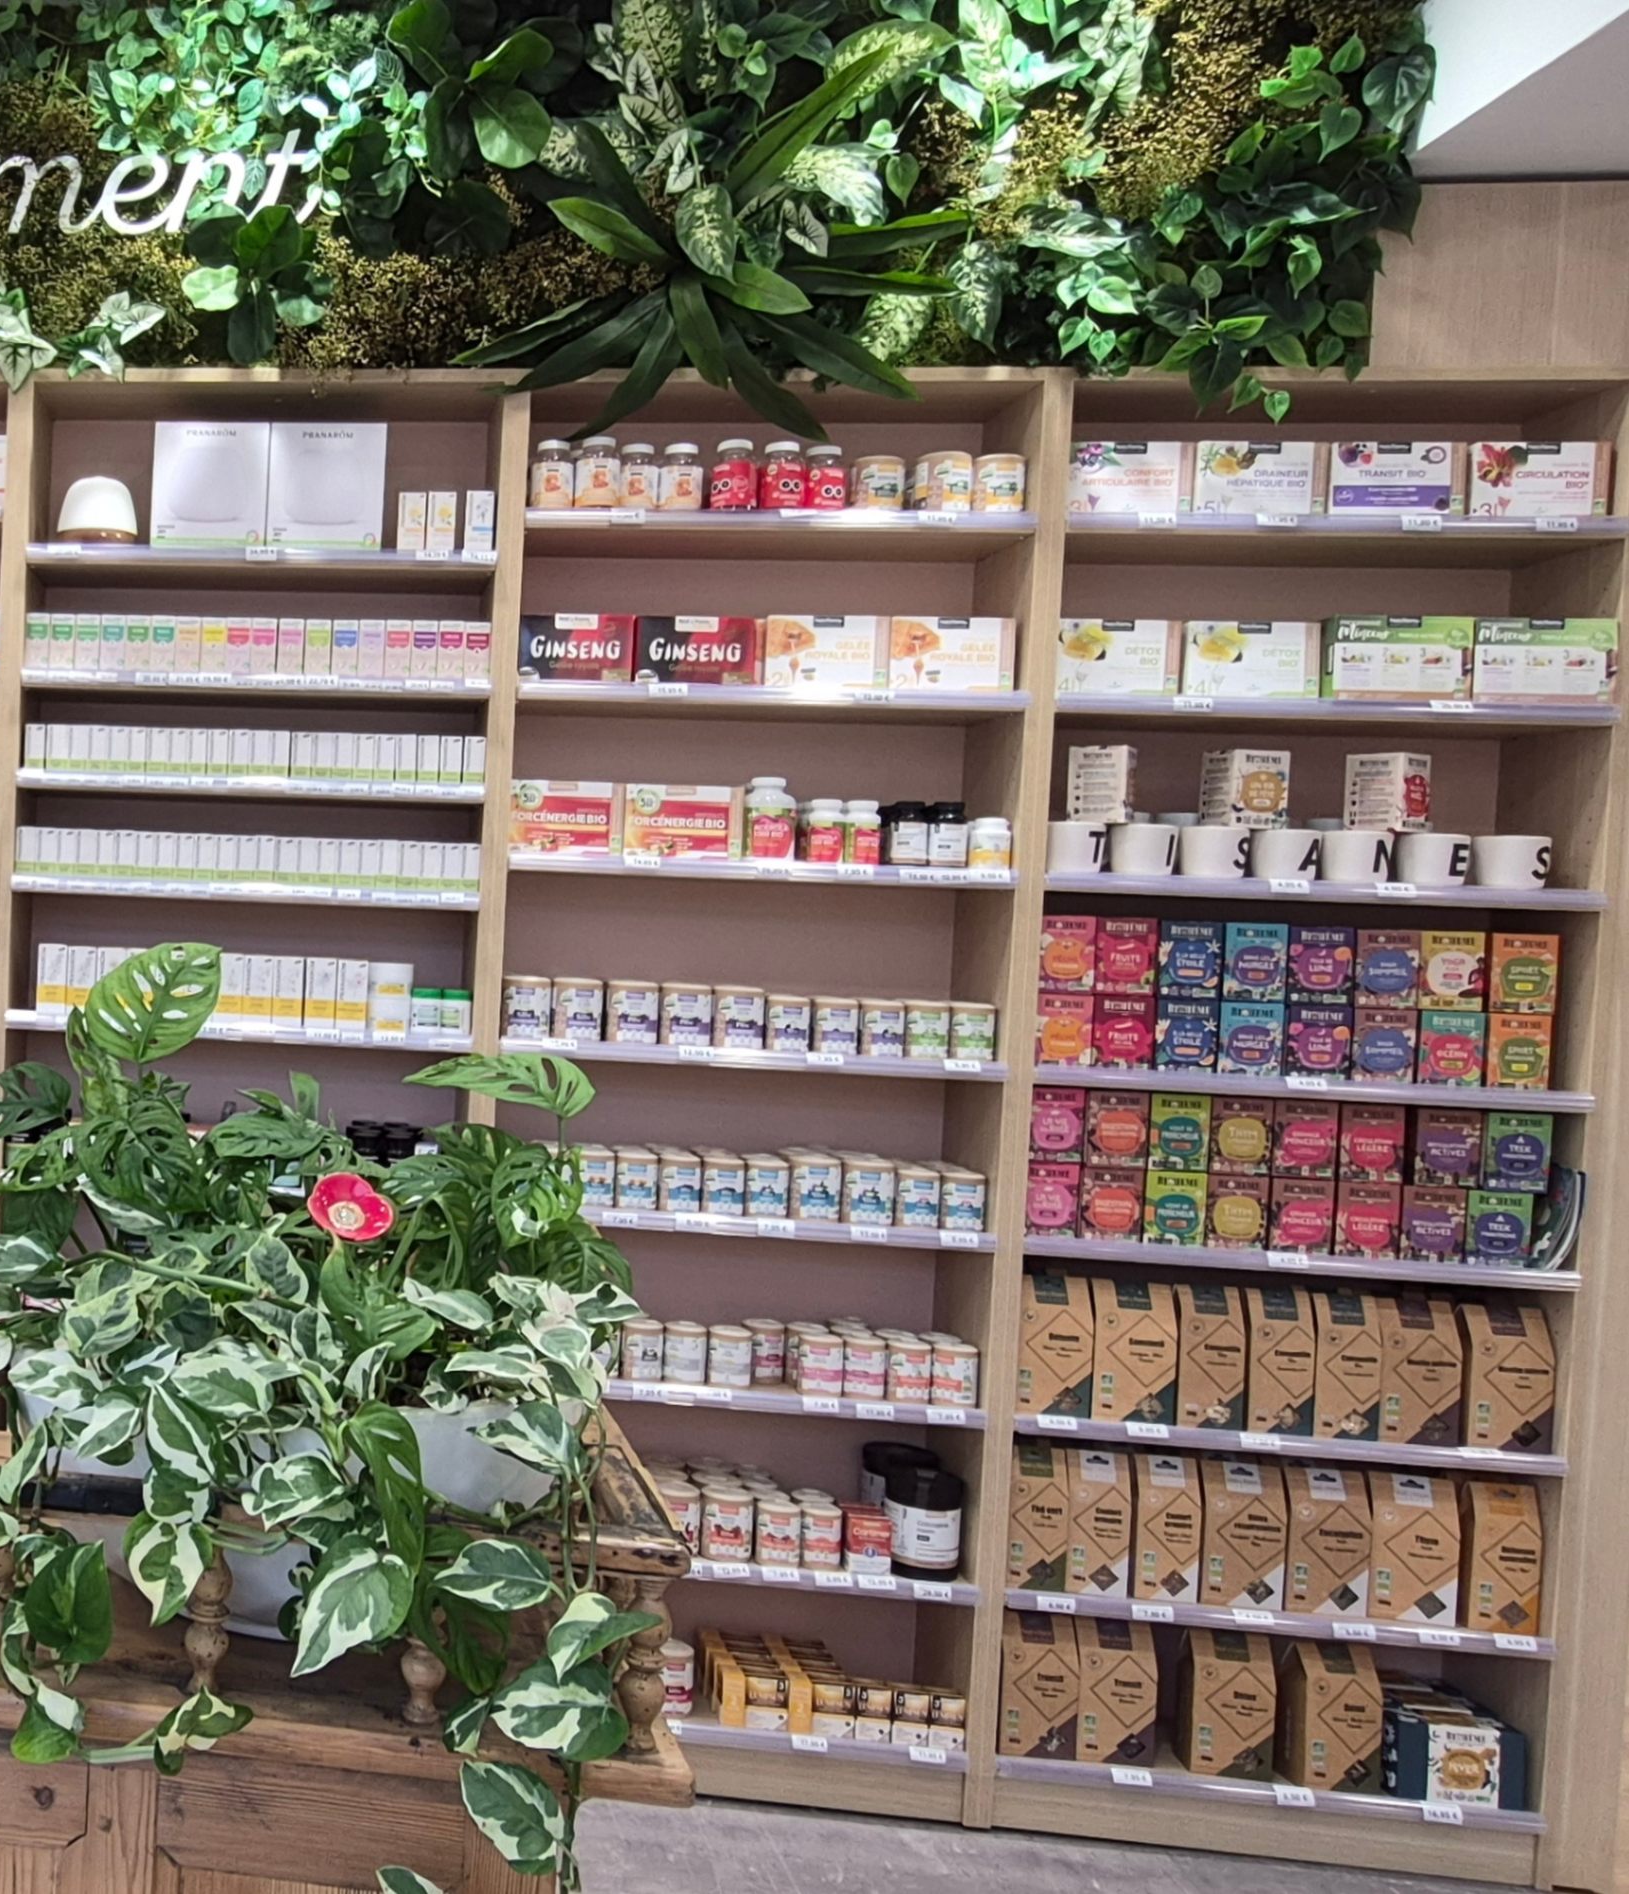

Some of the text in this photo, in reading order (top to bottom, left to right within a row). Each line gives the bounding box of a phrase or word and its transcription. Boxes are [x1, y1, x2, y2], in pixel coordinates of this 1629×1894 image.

[1124, 467, 1175, 479] CONFORT
[1254, 467, 1309, 479] DRAINEUR
[1359, 469, 1401, 479] TRANSIT
[1515, 469, 1590, 481] CIRCULATION
[1082, 478, 1150, 490] ARTICULAIRE
[1227, 476, 1283, 490] HÉPATIQUE
[530, 634, 621, 662] GINSENG
[649, 637, 742, 664] GINSENG
